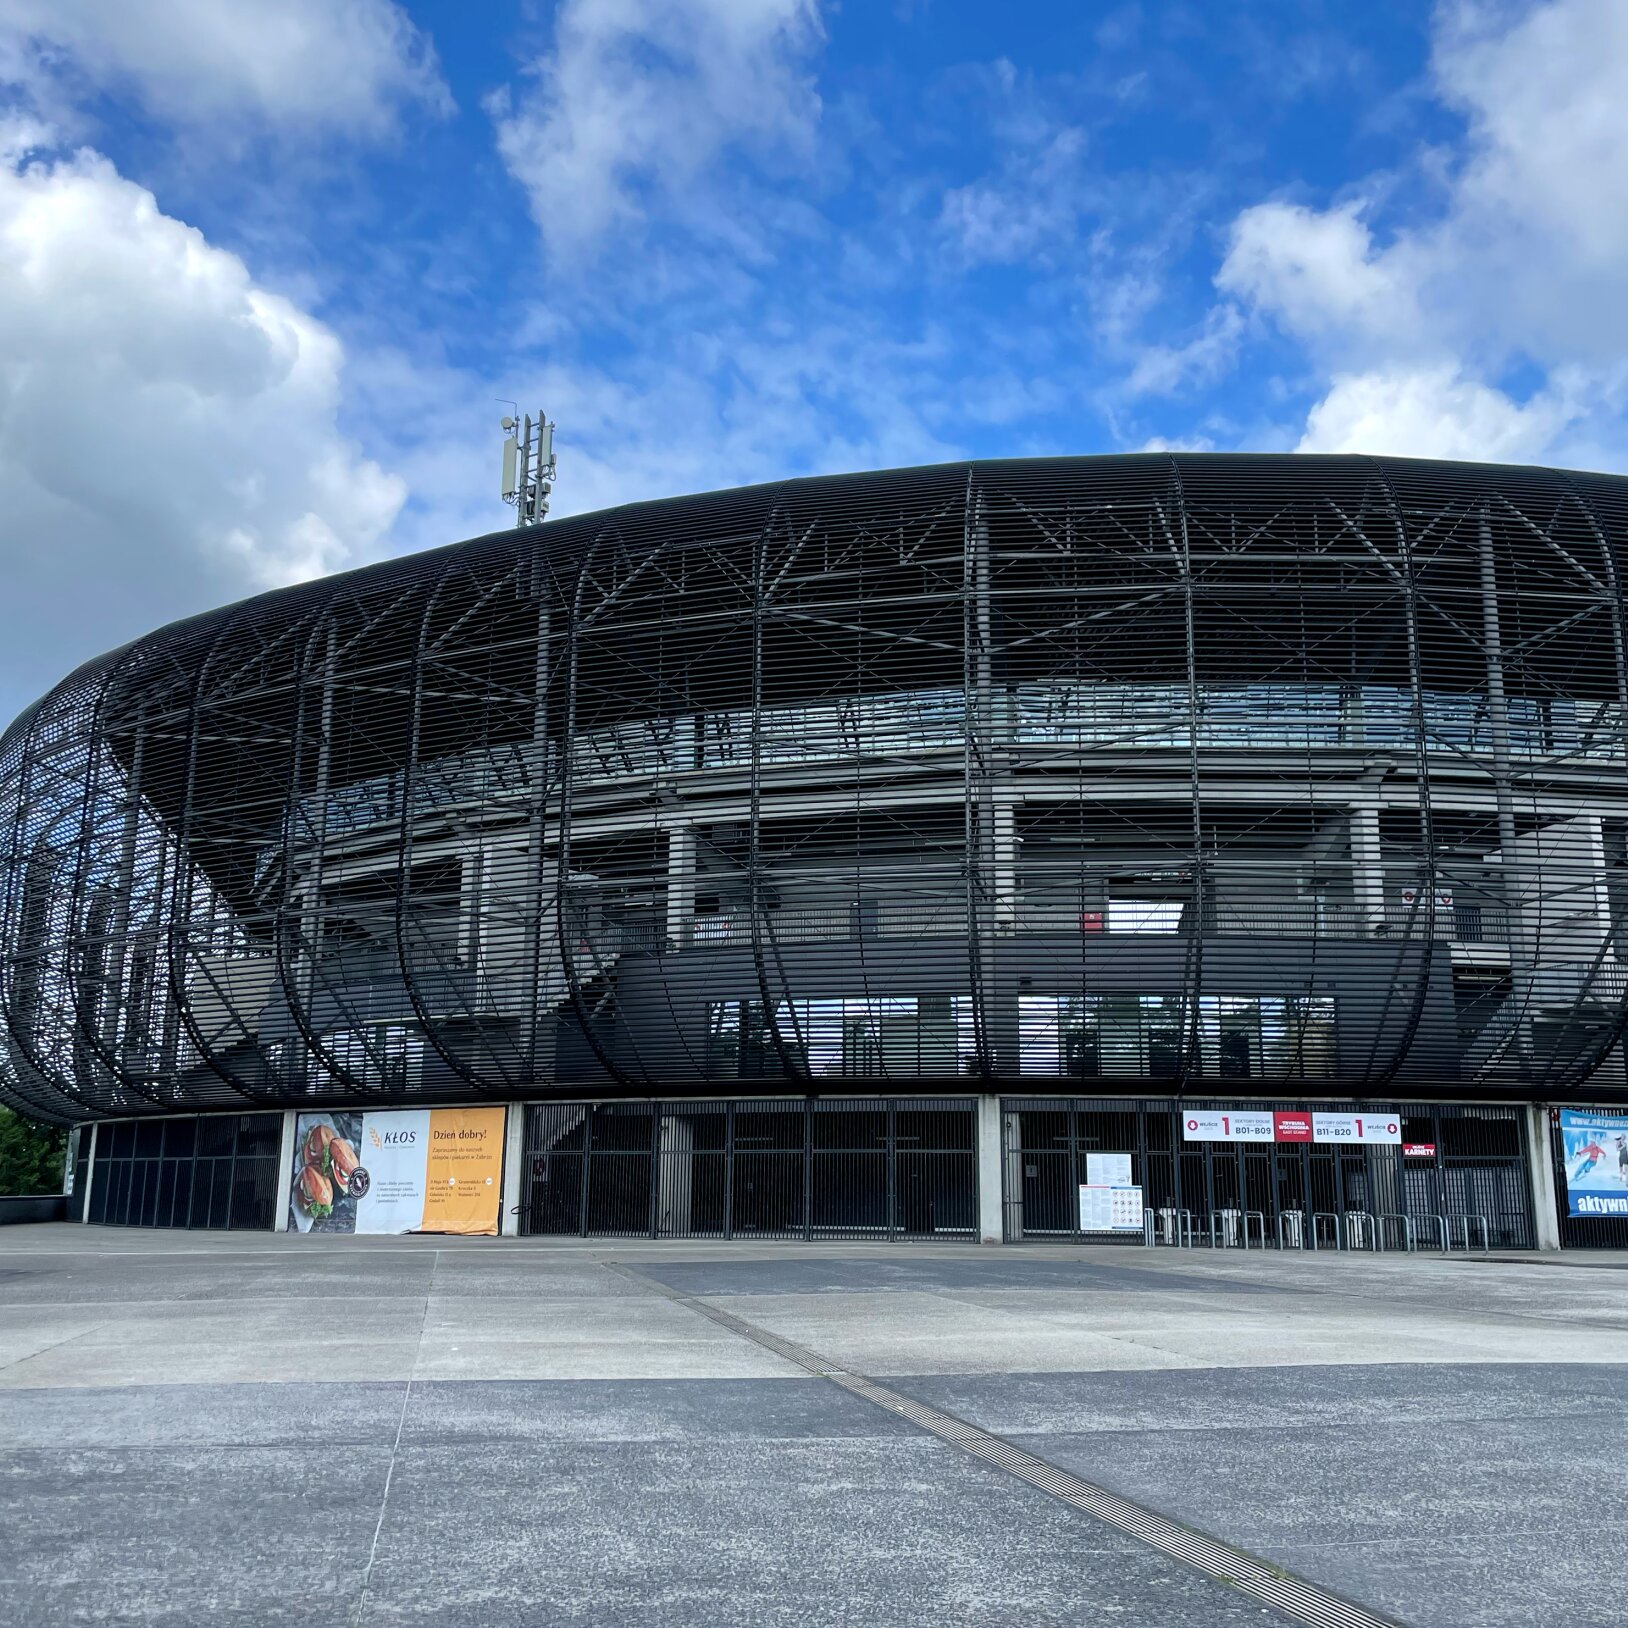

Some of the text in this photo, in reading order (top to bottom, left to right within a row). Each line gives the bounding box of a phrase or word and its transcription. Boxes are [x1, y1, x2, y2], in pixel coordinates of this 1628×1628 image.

[1221, 1117, 1229, 1135] 1
[1235, 1127, 1271, 1135] B01-B09
[1316, 1128, 1351, 1136] B11-B20
[1355, 1119, 1363, 1137] 1
[384, 1131, 417, 1144] KŁOS
[433, 1129, 487, 1141] Dzień dobry!
[1404, 1148, 1435, 1156] KARNETY
[1578, 1195, 1628, 1214] aktywn
